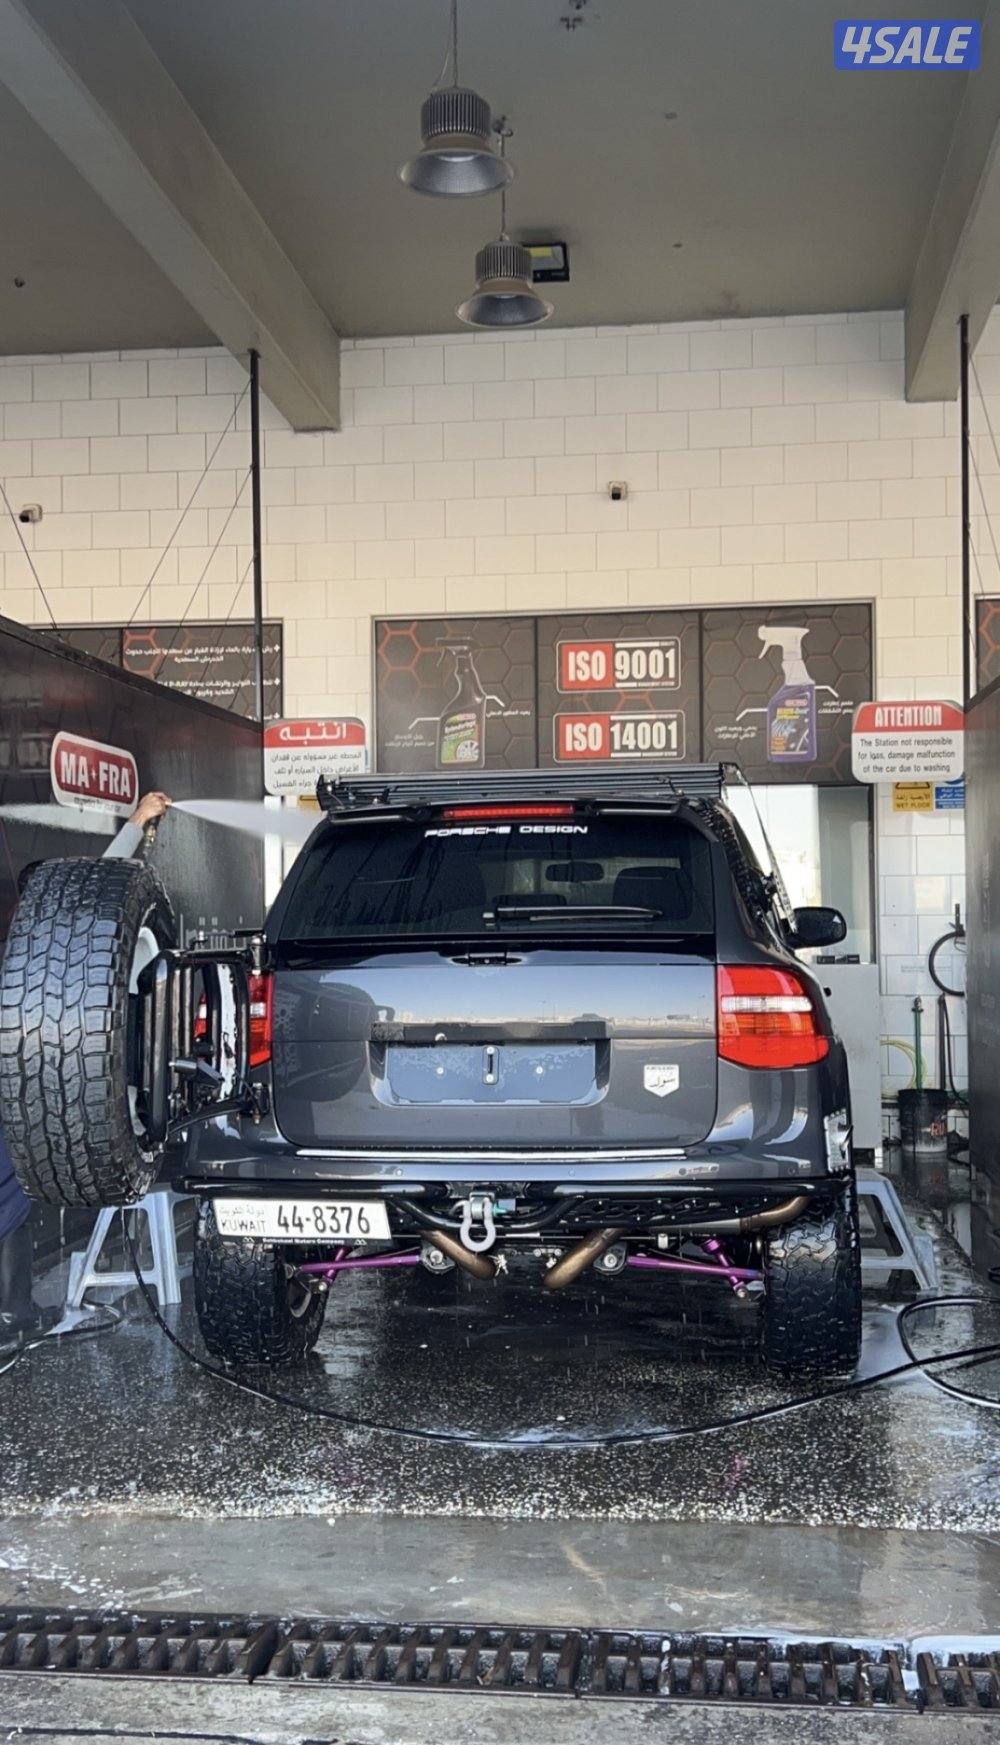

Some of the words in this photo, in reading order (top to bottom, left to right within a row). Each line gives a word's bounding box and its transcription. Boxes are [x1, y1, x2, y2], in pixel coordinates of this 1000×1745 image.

[568, 651, 606, 682] ISO
[615, 648, 676, 680] 9001
[875, 705, 942, 728] ATTENTION
[280, 721, 347, 746] انتبه
[565, 722, 603, 752] ISO
[610, 720, 677, 750] 14001
[860, 738, 872, 747] The
[875, 738, 899, 747] Station
[900, 738, 912, 746] not
[914, 737, 953, 747] responsible
[888, 751, 914, 760] damage
[916, 750, 956, 759] malfunction
[885, 765, 896, 773] car
[923, 764, 951, 774] washing
[424, 826, 511, 838] PORSCHE
[519, 825, 588, 834] DESIGN
[220, 1218, 267, 1233] KUWAIT
[277, 1205, 370, 1235] 44-8376
